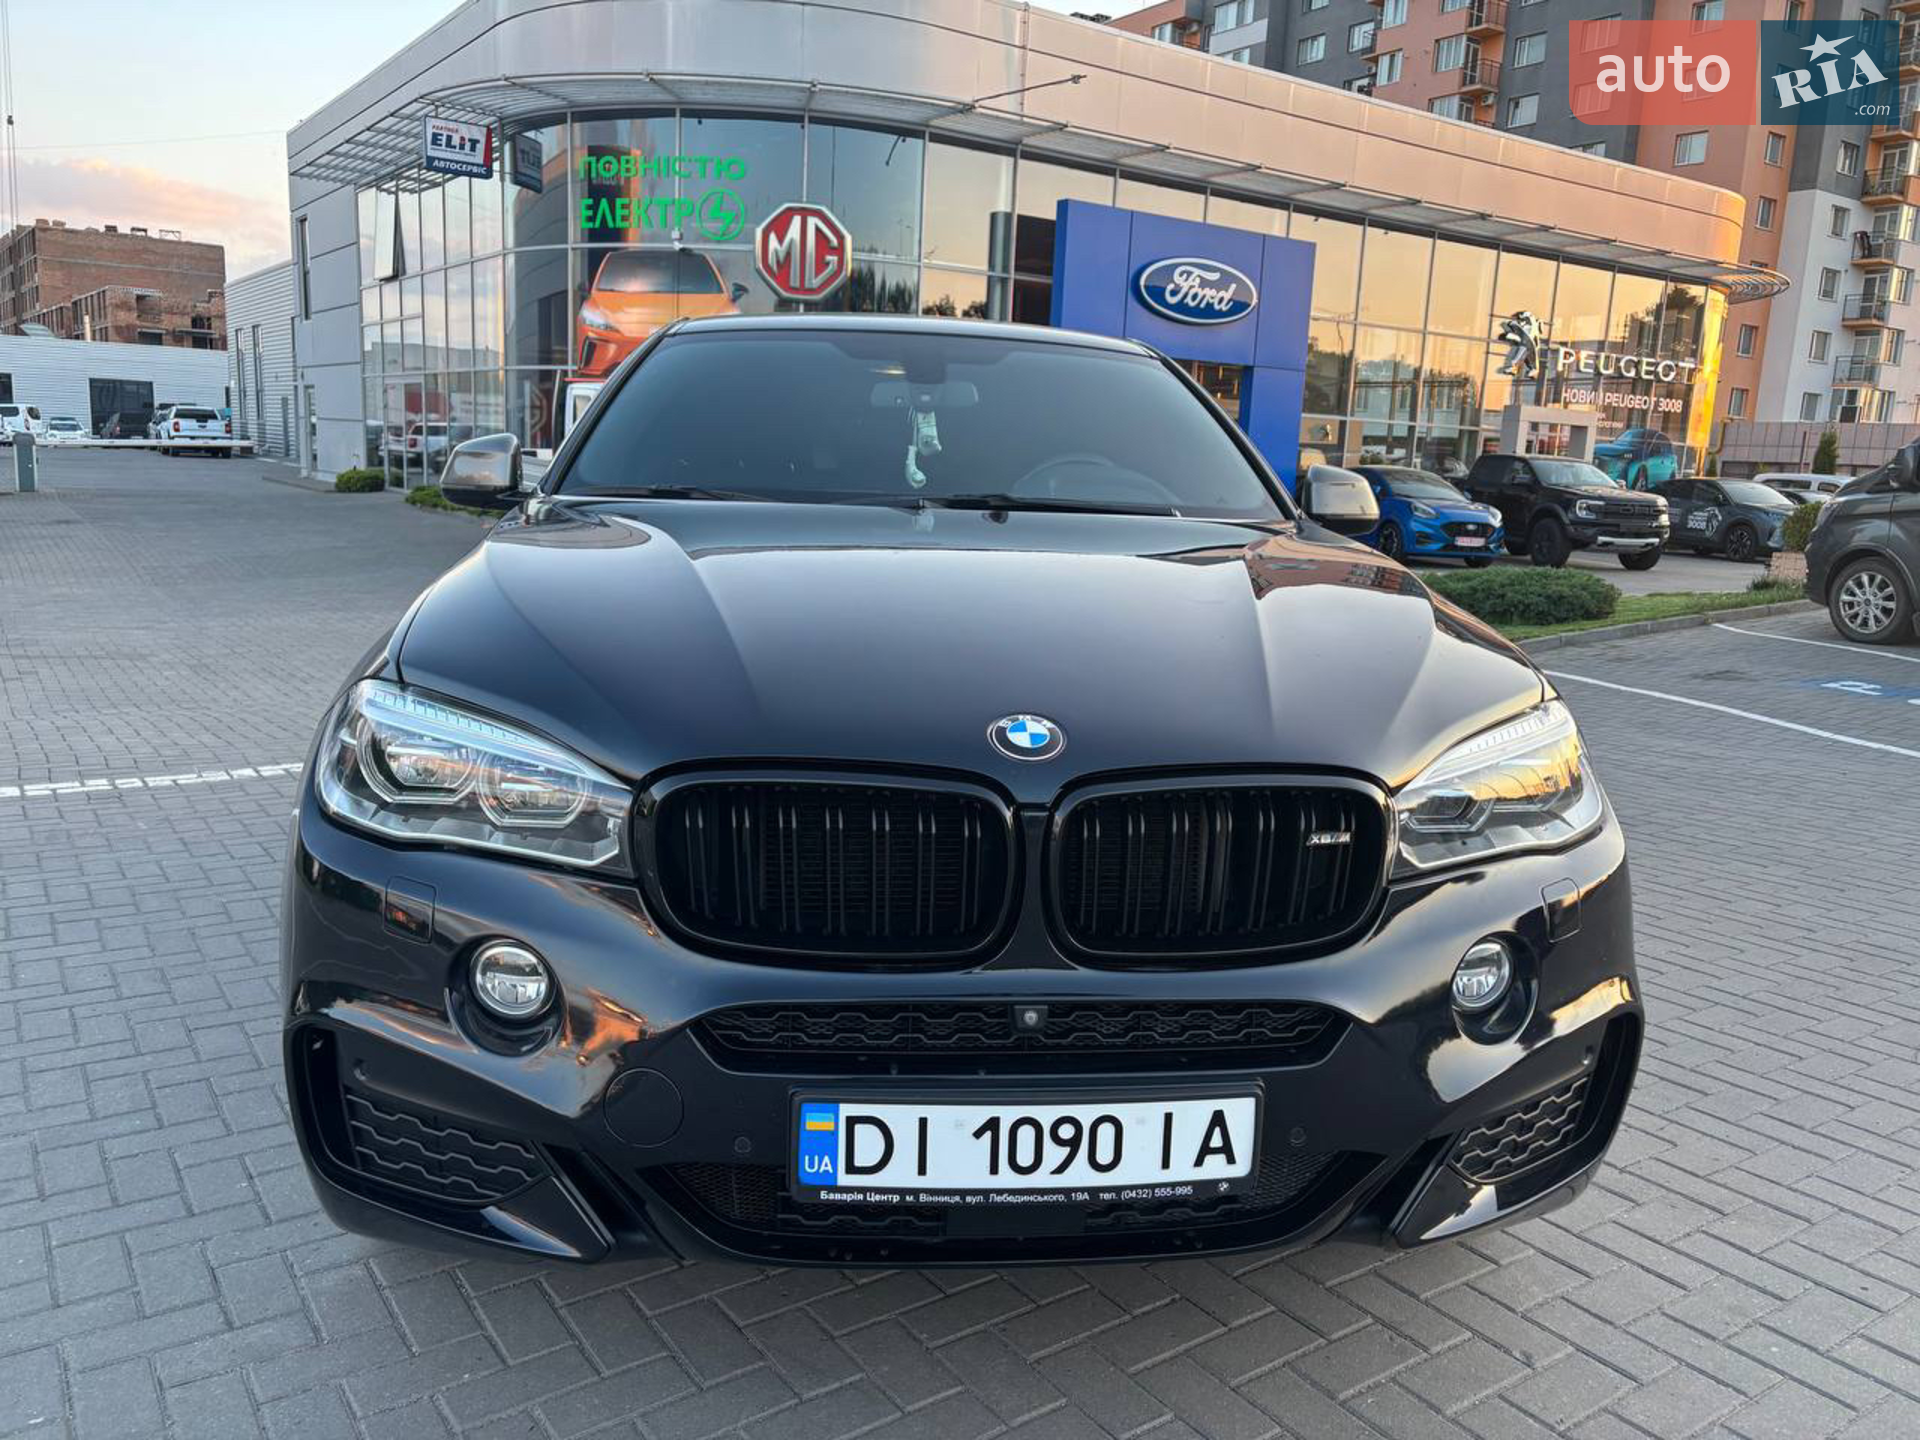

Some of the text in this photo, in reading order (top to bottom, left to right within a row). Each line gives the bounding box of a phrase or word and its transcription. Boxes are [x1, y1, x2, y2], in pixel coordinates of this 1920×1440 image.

[433, 159, 487, 175] АВТОСЕРВІС
[578, 155, 746, 182] ПОВНІСТЮ
[767, 213, 839, 290] MG
[1164, 264, 1237, 312] Ford
[1556, 346, 1696, 384] PEUGEOT
[1604, 392, 1657, 411] PEUGEOT
[1658, 397, 1683, 414] 3008
[844, 1109, 1237, 1177] DI 1090 IA
[804, 1154, 834, 1174] UA
[820, 1190, 864, 1202] Баварія
[866, 1191, 900, 1203] Центр
[918, 1192, 963, 1204] Вінниця,
[965, 1194, 986, 1205] вул.
[988, 1192, 1068, 1204] Лебединського,
[1099, 1191, 1119, 1201] тел.
[1121, 1187, 1152, 1201] (0432)
[1154, 1184, 1194, 1197] 555-995
